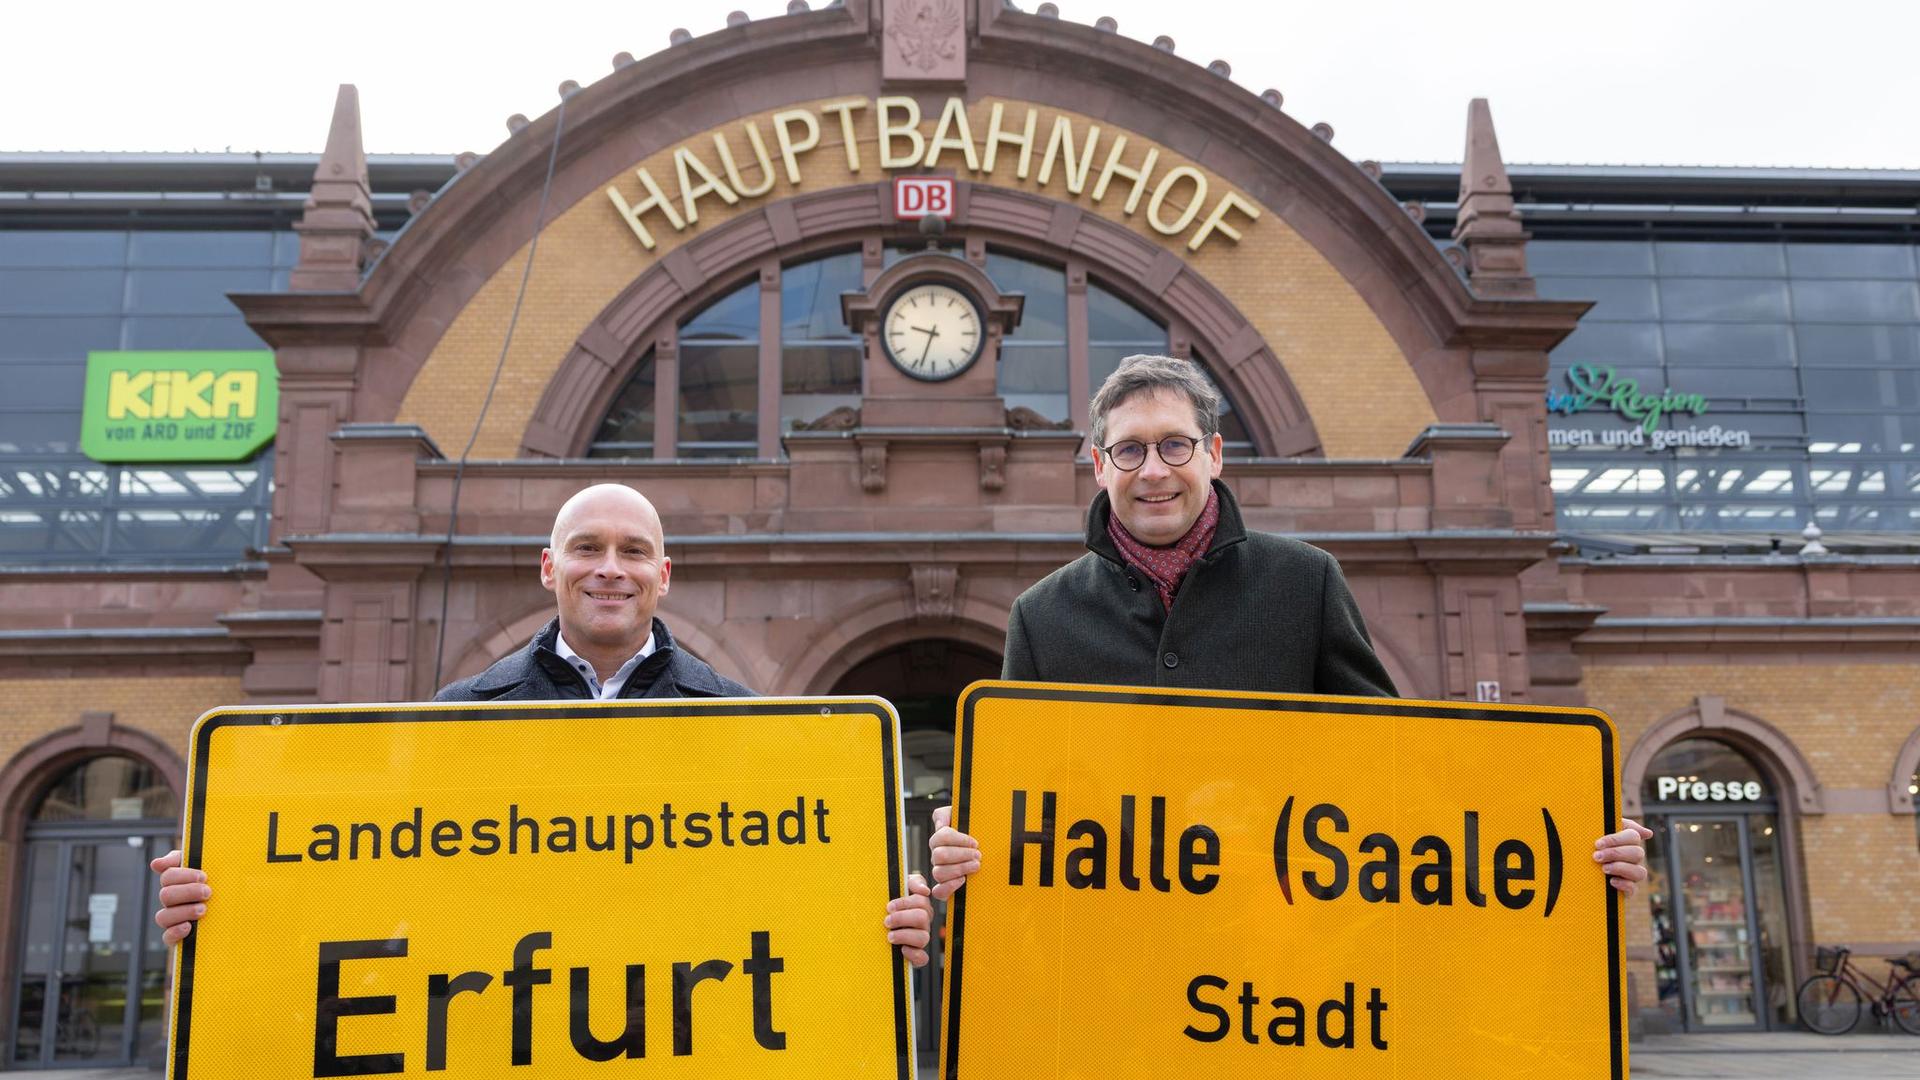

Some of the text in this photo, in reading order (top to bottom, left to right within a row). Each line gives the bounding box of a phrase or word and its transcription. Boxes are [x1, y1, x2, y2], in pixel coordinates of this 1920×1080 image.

[606, 95, 1261, 252] HAUPTBAHNHOF
[904, 184, 947, 211] DB
[105, 423, 256, 440] von ARD und ZDF
[1611, 378, 1709, 434] Region
[1602, 425, 1643, 445] und
[1651, 425, 1750, 449] genießen
[1480, 683, 1497, 701] 12
[1658, 777, 1761, 801] Presse
[266, 796, 831, 865] Landeshauptstadt
[1008, 790, 1564, 918] Halle (Saale)
[312, 931, 787, 1079] Erfurt
[1183, 974, 1389, 1051] Stadt
